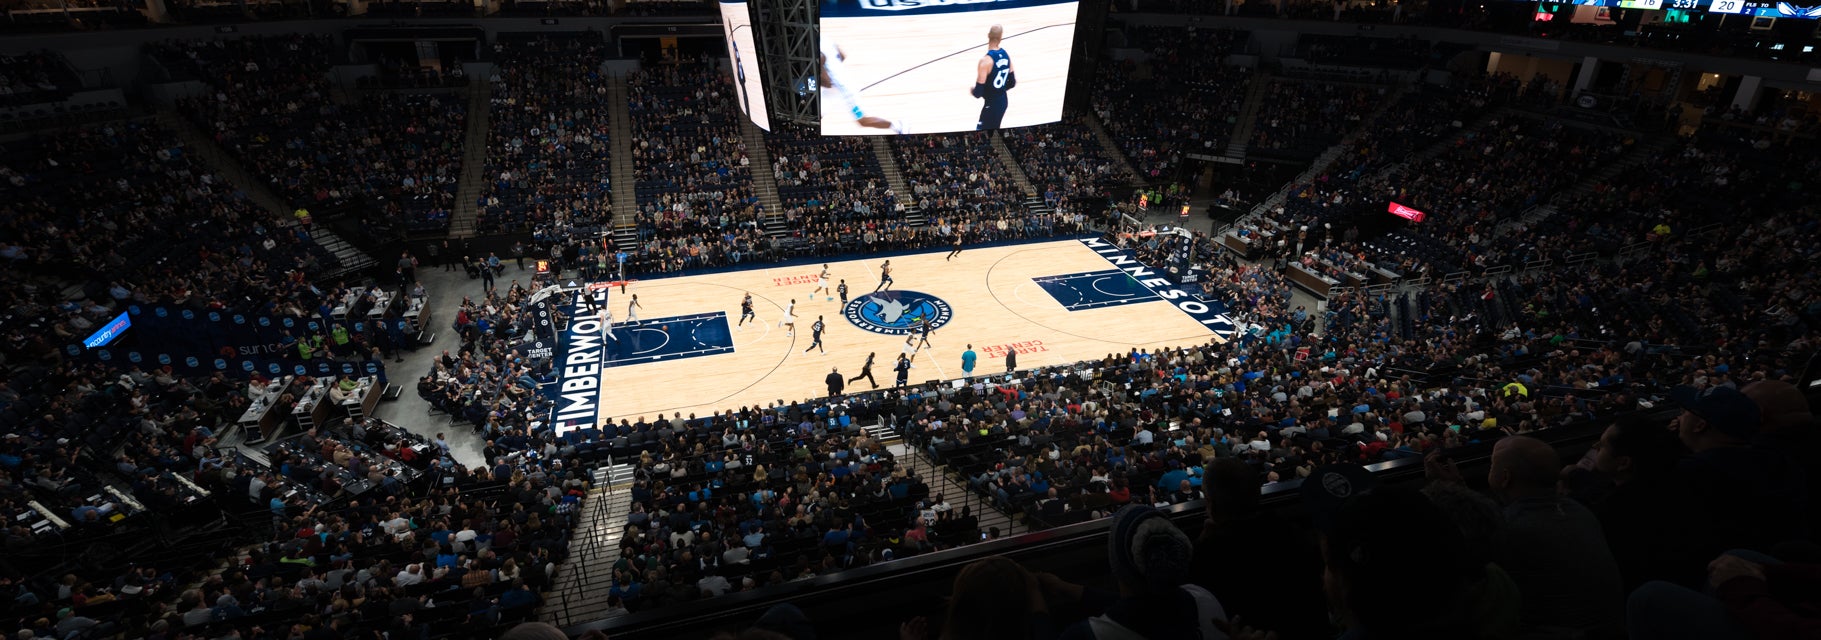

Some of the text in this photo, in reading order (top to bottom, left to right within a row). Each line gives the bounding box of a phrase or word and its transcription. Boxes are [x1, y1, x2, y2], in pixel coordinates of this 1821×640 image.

[1718, 1, 1735, 11] 20
[993, 68, 1010, 89] 67
[988, 345, 1050, 359] TARET
